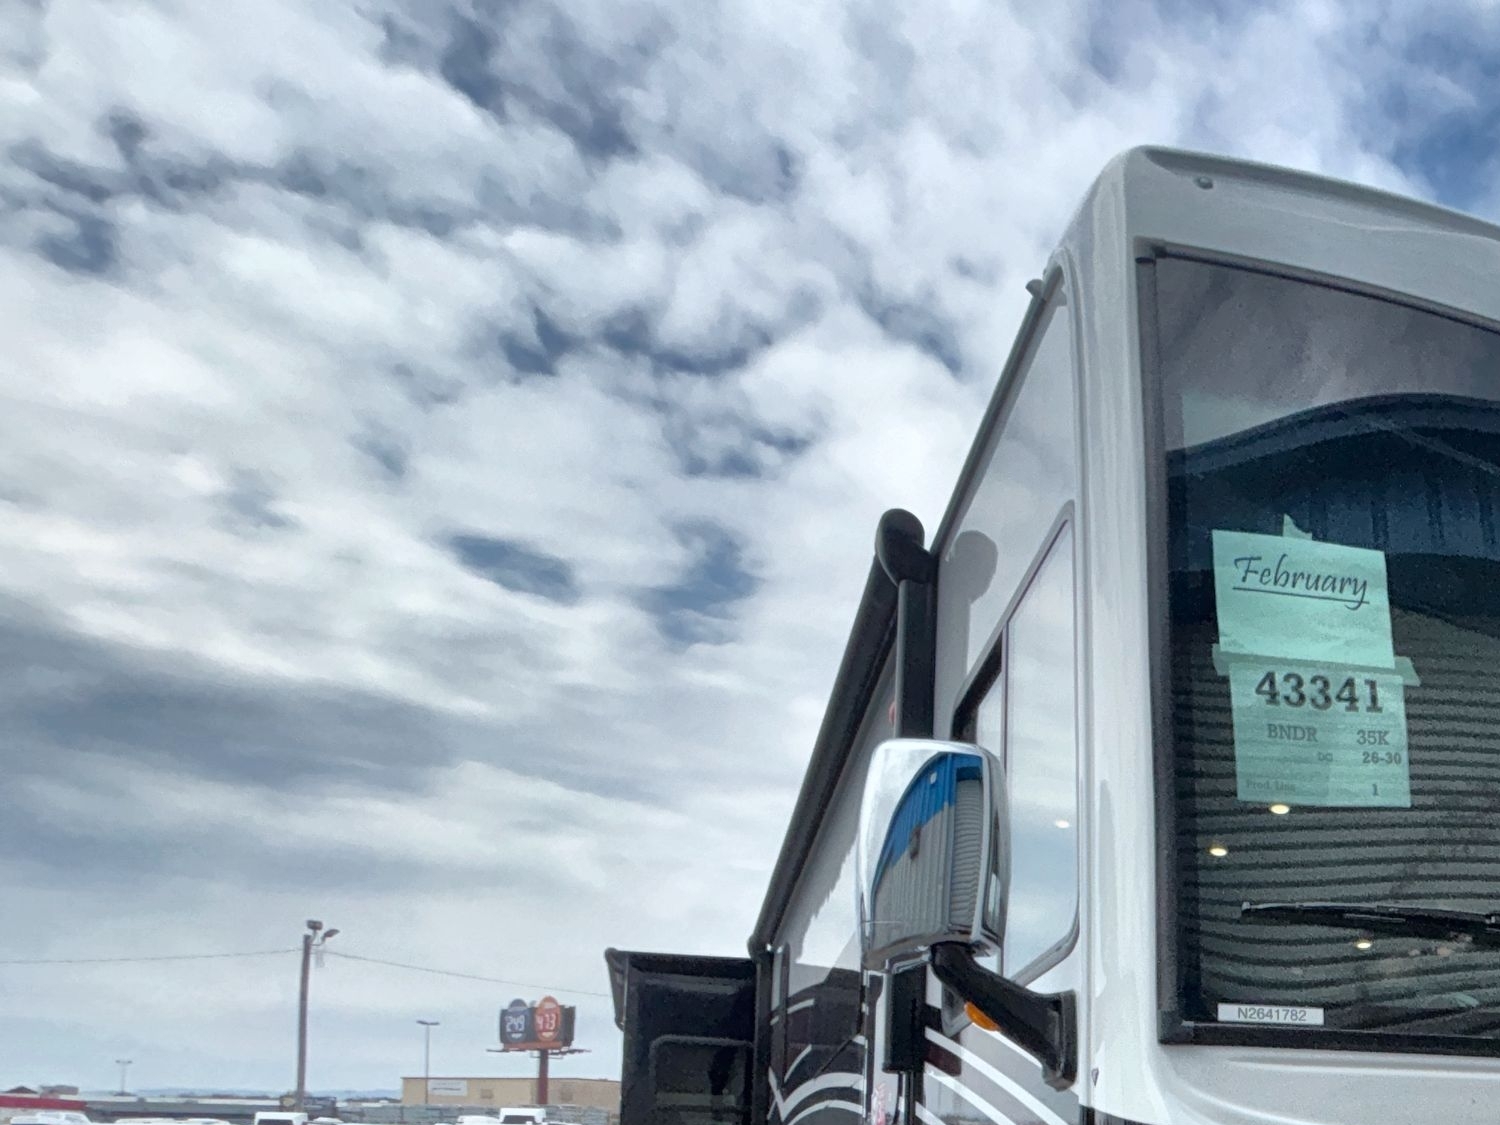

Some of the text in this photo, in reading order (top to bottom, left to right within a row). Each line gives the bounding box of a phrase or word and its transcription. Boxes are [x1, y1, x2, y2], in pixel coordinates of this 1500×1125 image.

[1233, 554, 1368, 610] February
[1254, 671, 1383, 713] 43341
[1267, 723, 1390, 746] BNDR 35K
[1237, 1006, 1307, 1022] N2641782
